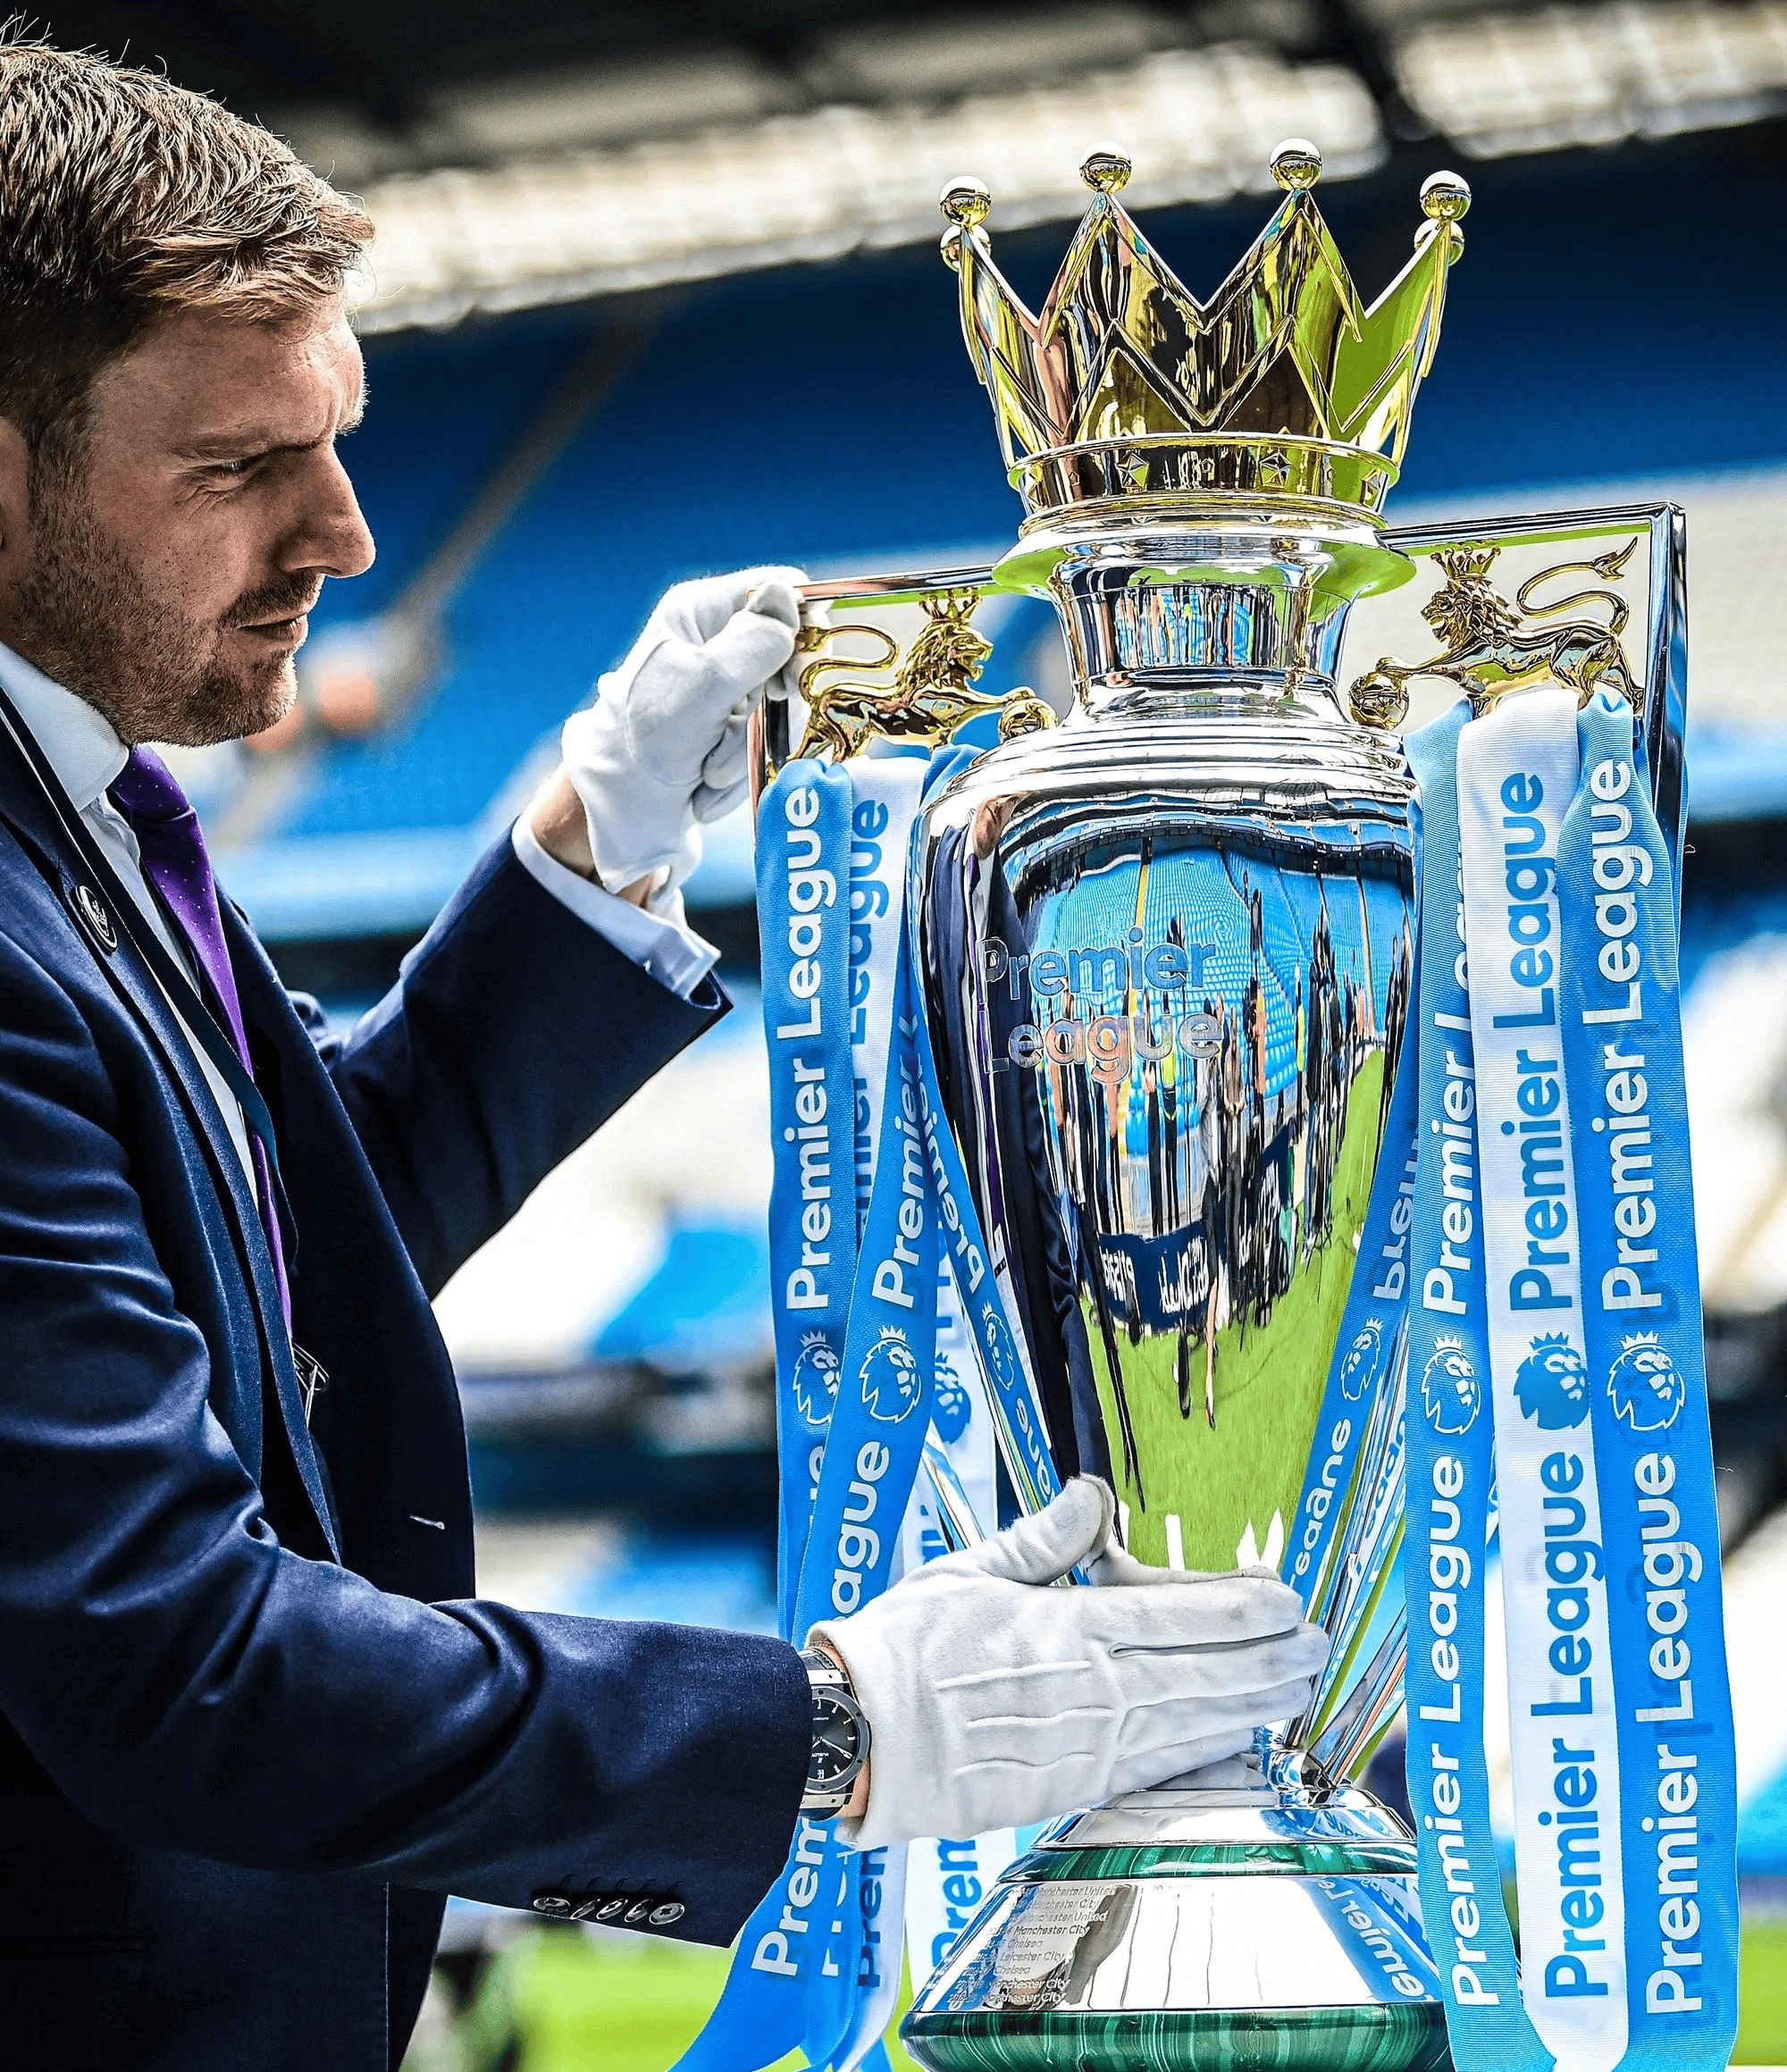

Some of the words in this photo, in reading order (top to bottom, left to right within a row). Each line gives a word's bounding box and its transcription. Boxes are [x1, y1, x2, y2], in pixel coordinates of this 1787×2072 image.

[777, 786, 837, 1042] League
[976, 926, 1216, 1004] Premier
[1492, 770, 1557, 1029] League
[1582, 759, 1652, 1026] League
[979, 1011, 1222, 1086] League
[784, 1057, 832, 1311] Premier
[1422, 1049, 1475, 1315] Premier
[1501, 1049, 1573, 1313] Premier
[1592, 1044, 1662, 1310] Premier
[831, 1440, 890, 1621] ague
[1420, 1455, 1472, 1723] League
[1531, 1451, 1606, 1716] League
[1635, 1453, 1703, 1723] League
[751, 1817, 828, 1976] Prem
[1000, 1951, 1041, 1962] Leicester
[1043, 1950, 1065, 1963] City
[1013, 1925, 1067, 1934] Manchester
[1069, 1924, 1090, 1936] City
[1045, 1977, 1072, 1990] City
[1078, 1899, 1100, 1909] City
[1424, 1751, 1499, 2006] Premier
[1540, 1738, 1608, 1998] Premier
[1641, 1751, 1702, 2015] Premier
[1041, 1991, 1067, 2004] City
